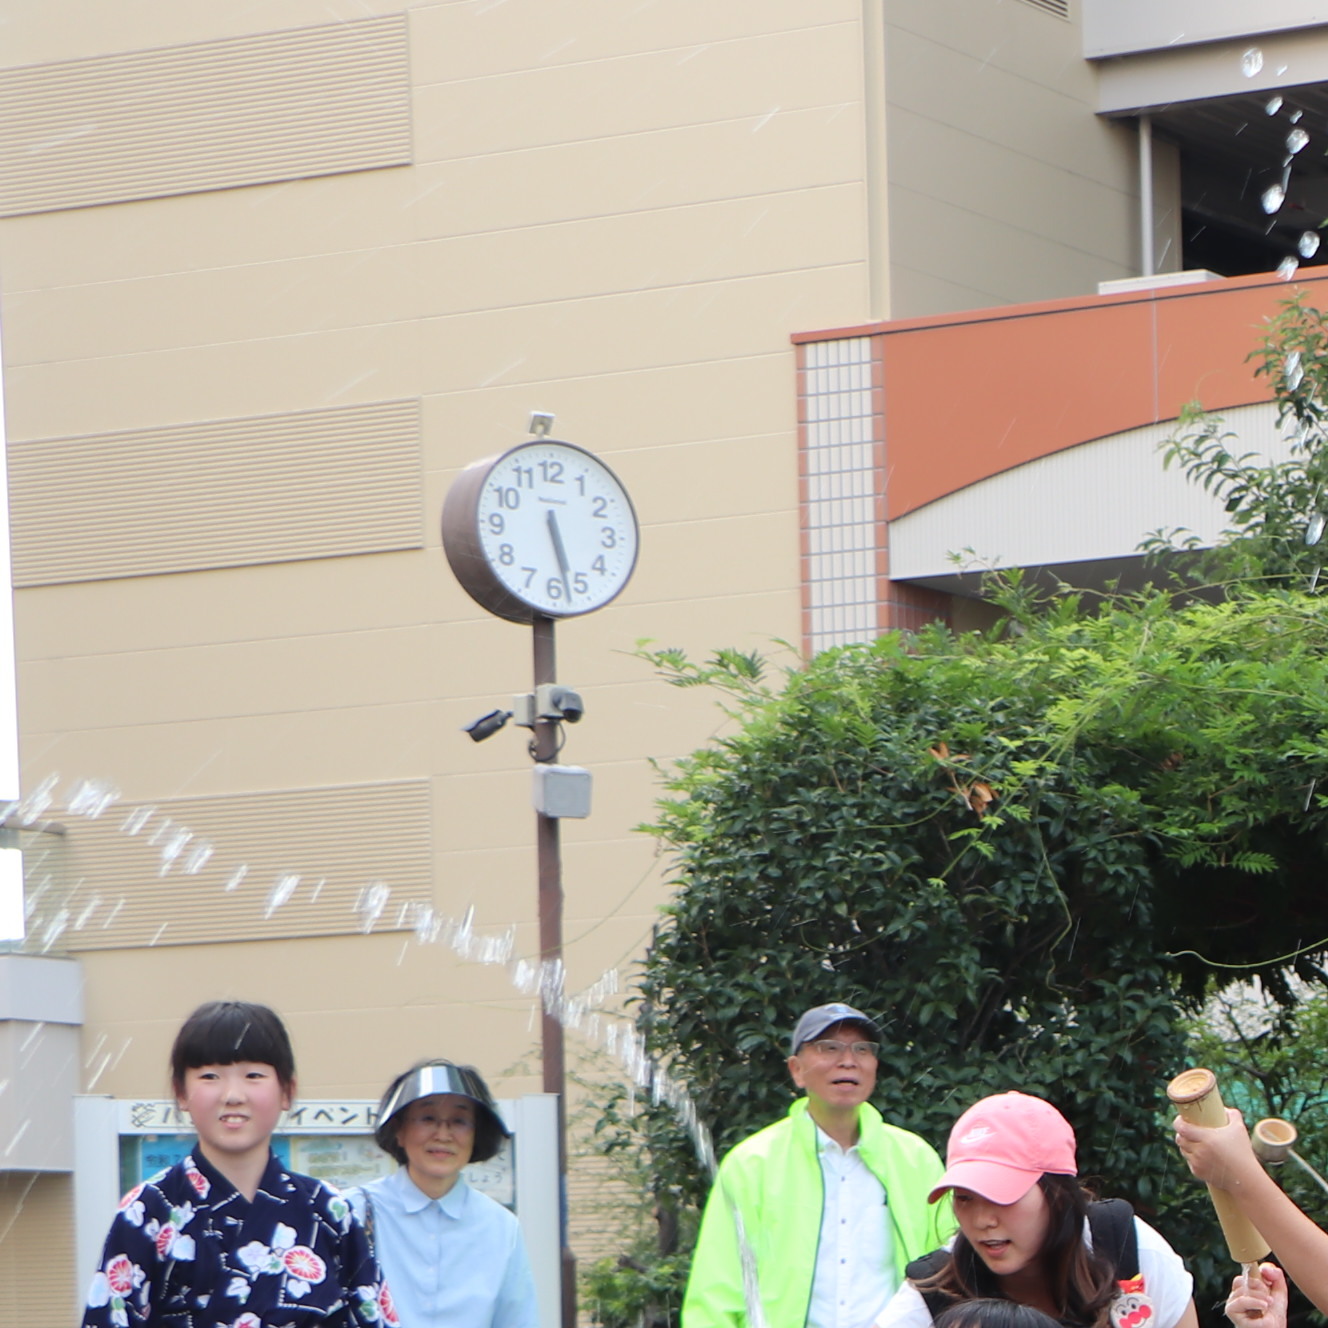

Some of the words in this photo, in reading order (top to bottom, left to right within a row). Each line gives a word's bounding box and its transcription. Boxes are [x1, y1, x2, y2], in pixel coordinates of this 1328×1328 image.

[512, 465, 534, 489] 11
[537, 460, 565, 483] 12
[575, 474, 585, 496] 1
[494, 486, 520, 510] 10
[592, 496, 608, 518] 2
[488, 513, 505, 535] 9
[600, 526, 616, 549] 3
[499, 543, 515, 566] 8
[591, 555, 607, 576] 4
[521, 566, 537, 588] 7
[573, 572, 589, 594] 5
[546, 577, 563, 600] 6
